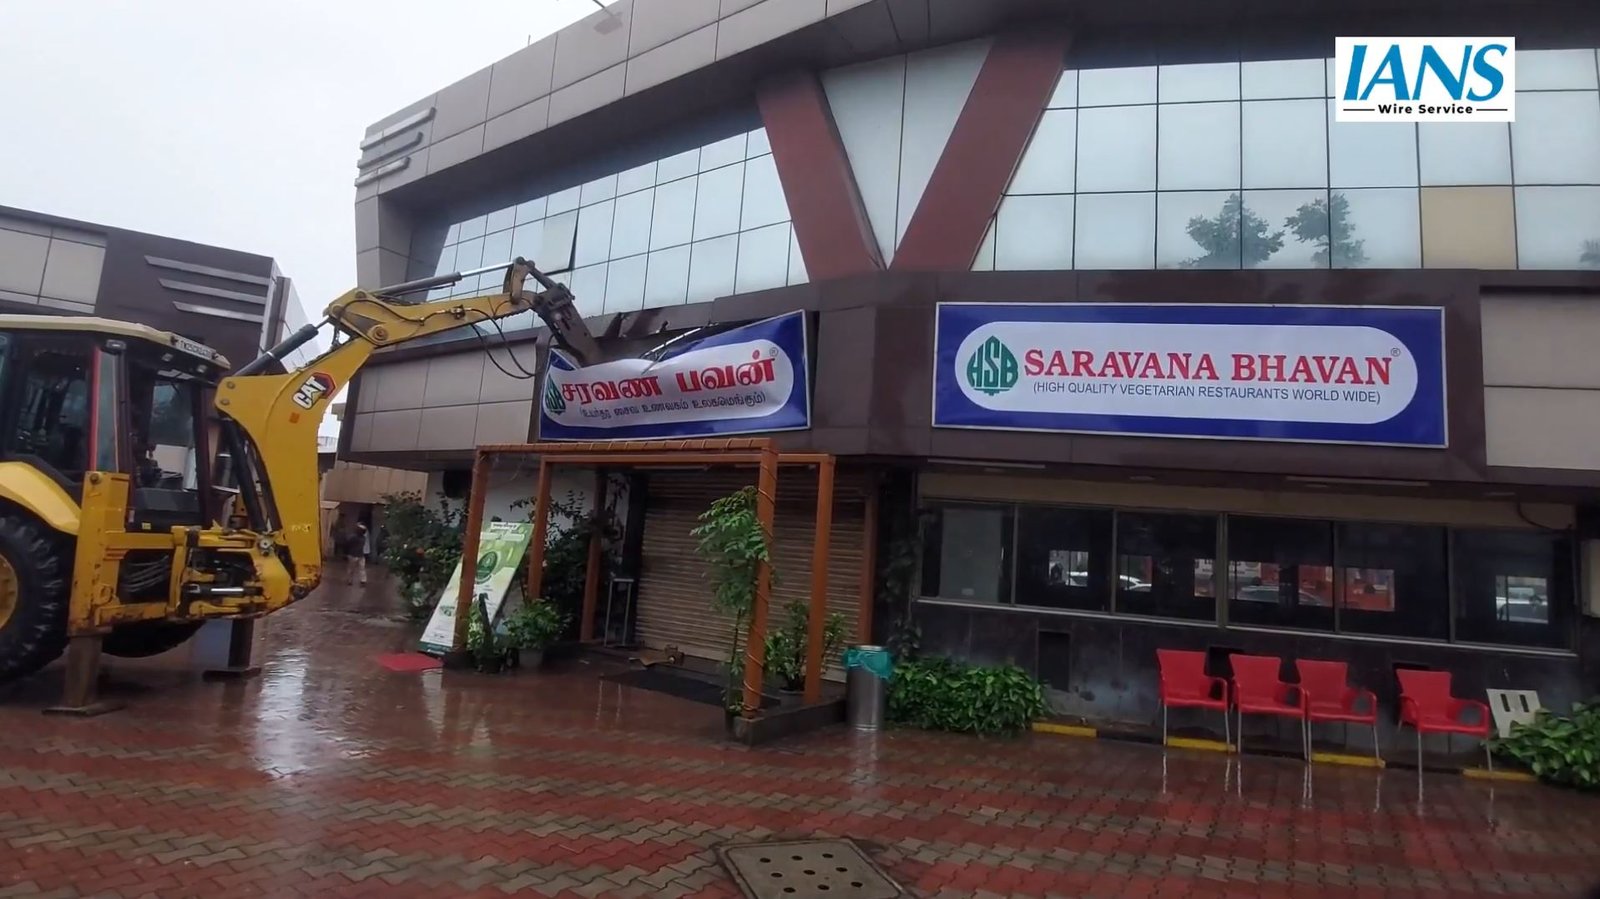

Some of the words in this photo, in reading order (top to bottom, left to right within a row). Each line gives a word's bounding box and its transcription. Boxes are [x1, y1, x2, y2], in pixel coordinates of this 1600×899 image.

[561, 376, 663, 405] சரவண
[675, 349, 776, 392] பவன்
[967, 335, 1018, 388] HSB
[1024, 349, 1219, 381] SARAVANA
[1231, 353, 1392, 385] BHAVAN
[292, 375, 327, 409] CAT
[1033, 382, 1065, 394] (HIGH
[1068, 383, 1117, 395] QUALITY
[1120, 384, 1195, 397] VEGETARIAN
[1198, 386, 1289, 400] RESTAURANTS
[1292, 388, 1340, 401] WORLD
[1342, 390, 1381, 405] WIDE)
